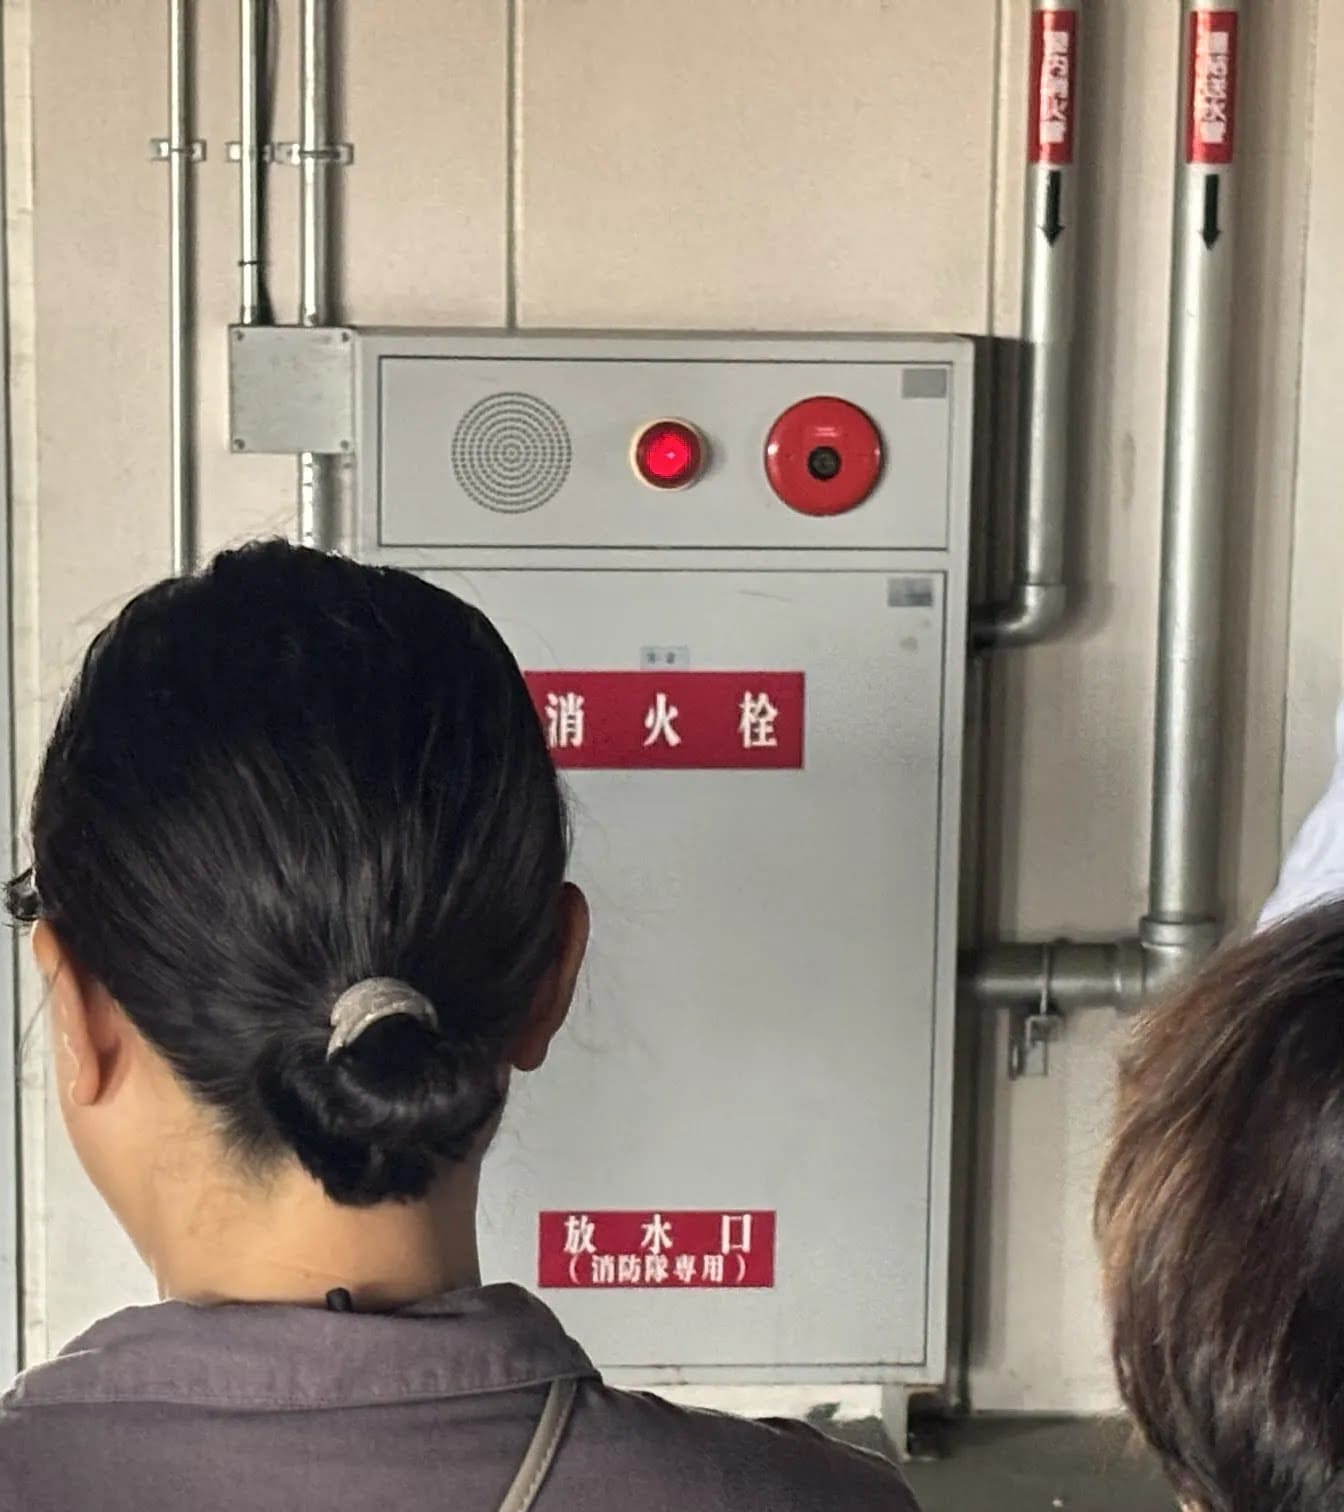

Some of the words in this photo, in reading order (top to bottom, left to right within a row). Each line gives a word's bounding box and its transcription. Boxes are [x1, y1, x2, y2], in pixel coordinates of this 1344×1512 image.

[544, 690, 779, 749] 消火栓
[563, 1213, 752, 1254] 放水口
